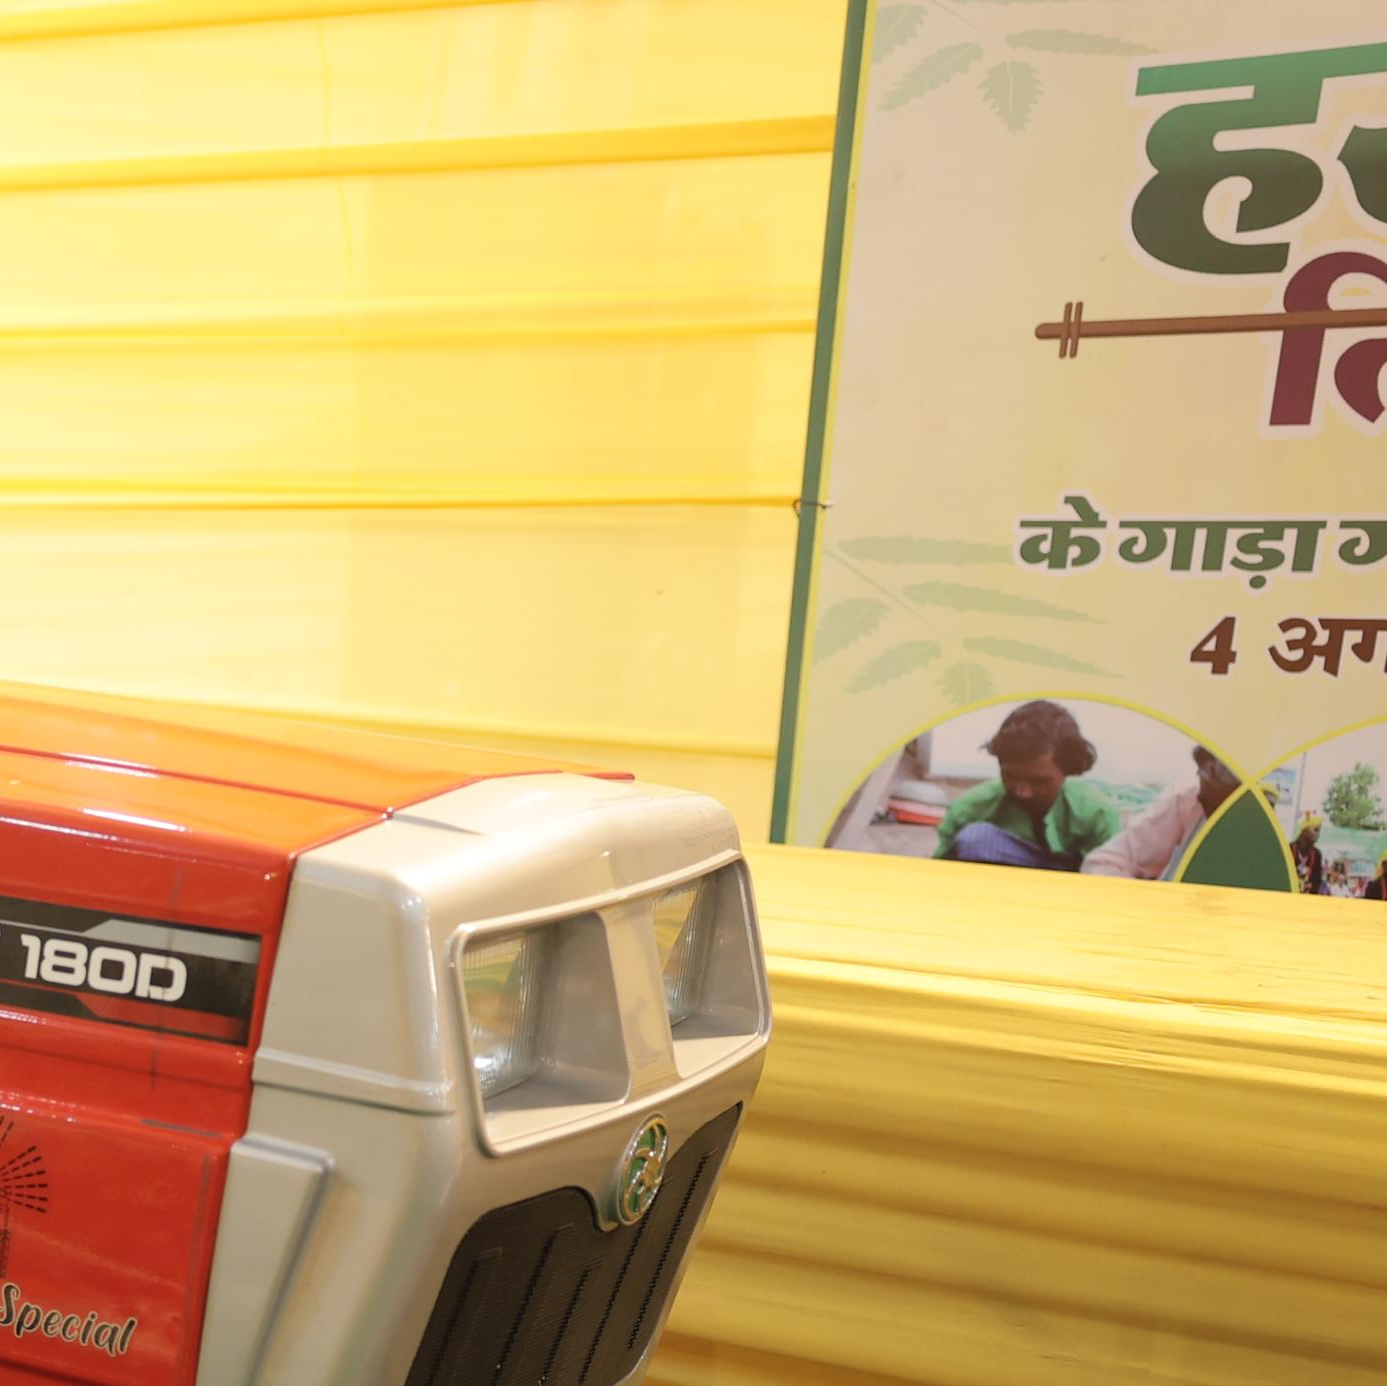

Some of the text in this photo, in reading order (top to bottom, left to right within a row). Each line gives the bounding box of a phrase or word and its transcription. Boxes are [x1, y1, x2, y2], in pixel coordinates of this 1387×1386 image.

[1019, 495, 1107, 570] के
[1118, 520, 1327, 589] गाड़ा
[1190, 616, 1237, 675] 4
[20, 932, 187, 1003] 180D
